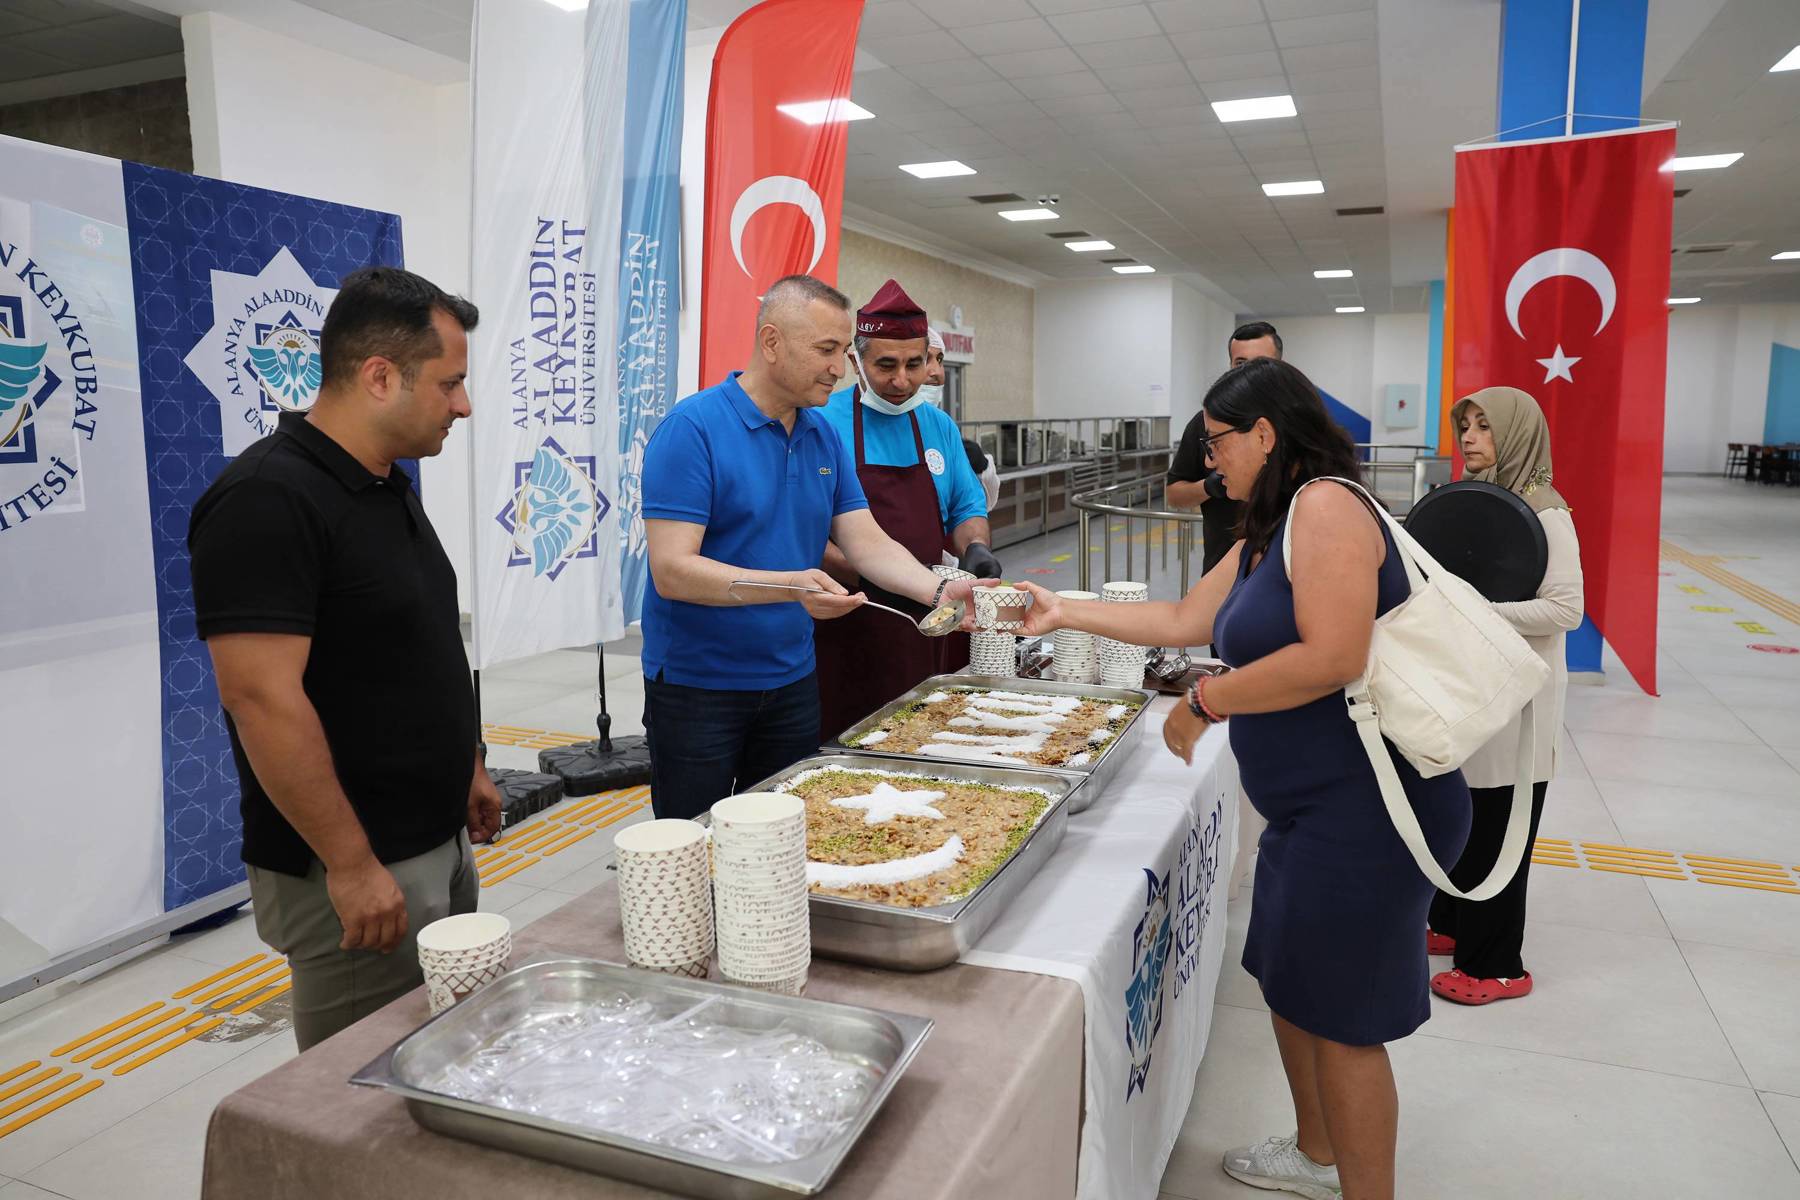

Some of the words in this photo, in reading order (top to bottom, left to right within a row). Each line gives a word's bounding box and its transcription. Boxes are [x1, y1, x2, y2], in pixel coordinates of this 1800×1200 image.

[16, 258, 98, 440] KEYKUBAT
[224, 318, 246, 397] ALANYA
[244, 289, 324, 317] ALAADDİN
[510, 337, 528, 430] ALANYA
[579, 271, 596, 426] ÜNİVERSİTESİ
[618, 341, 628, 425] ALANYA
[654, 280, 667, 418] ÜNİVERSİTESİ
